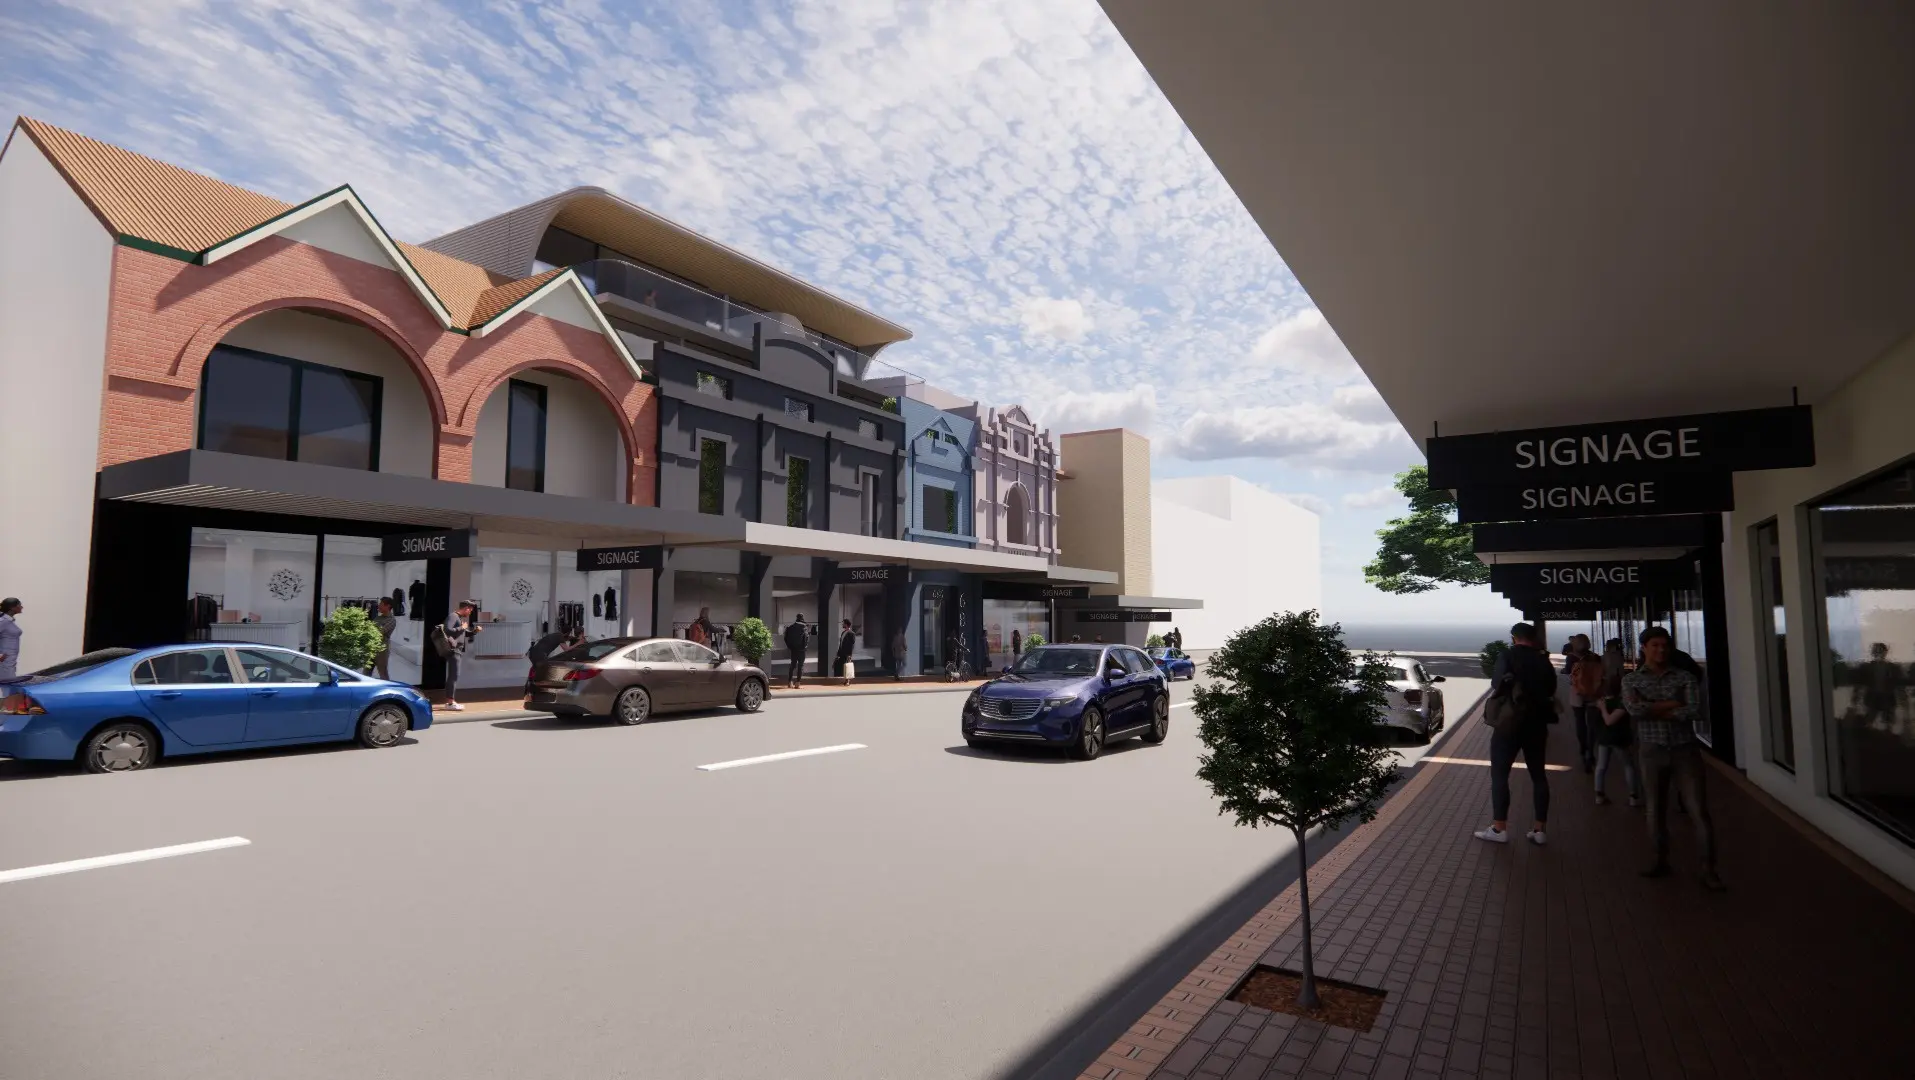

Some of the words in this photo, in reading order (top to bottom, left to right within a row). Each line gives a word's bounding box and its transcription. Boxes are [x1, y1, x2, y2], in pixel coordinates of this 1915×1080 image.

[1515, 427, 1701, 469] SIGNAGE
[1522, 482, 1656, 510] SIGNAGE
[402, 536, 446, 553] SIGNAGE
[597, 550, 640, 565] SIGNAGE
[851, 568, 889, 581] SIGNAGE
[1540, 566, 1640, 585] SIGNAGE
[1042, 589, 1073, 598] SIGNAGE
[1541, 611, 1579, 619] SIGNAGE
